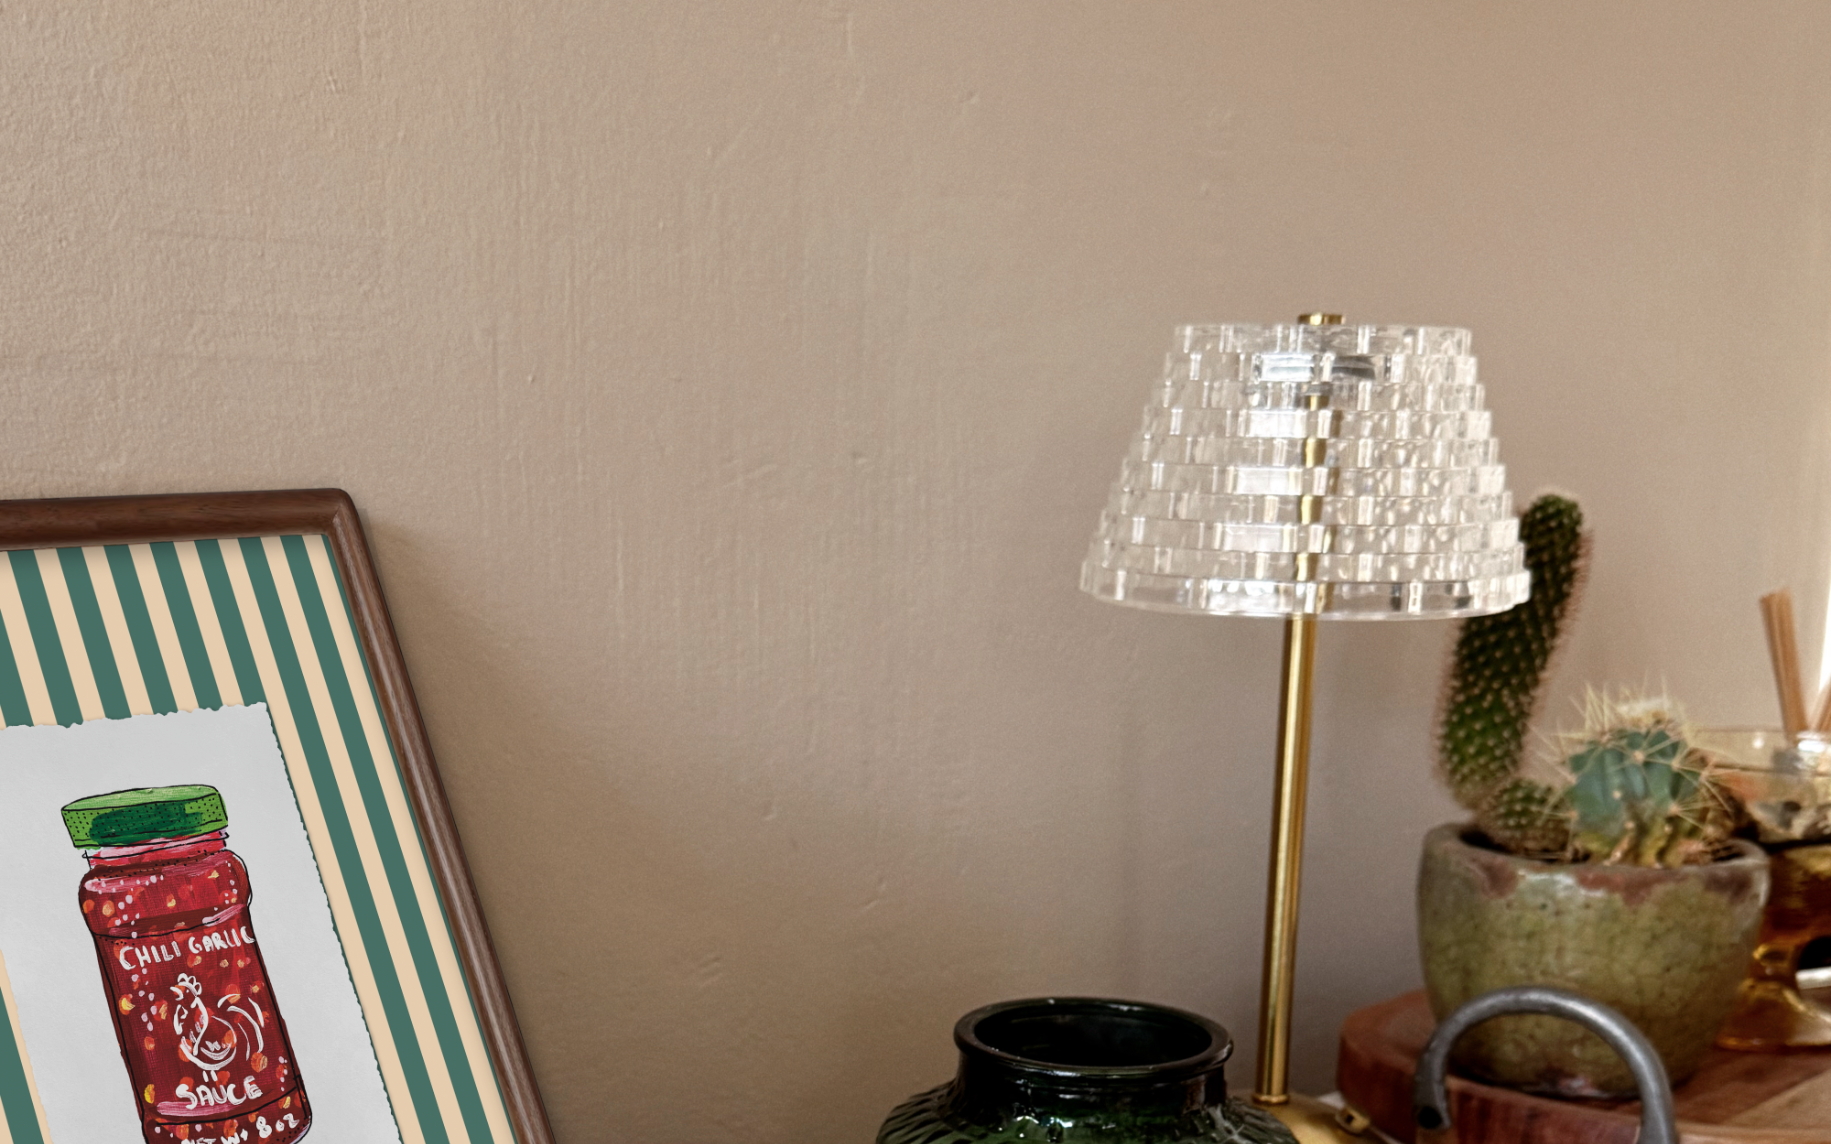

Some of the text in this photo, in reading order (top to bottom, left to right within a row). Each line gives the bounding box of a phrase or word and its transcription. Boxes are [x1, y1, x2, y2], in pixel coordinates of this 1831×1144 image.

[119, 926, 255, 970] CHILI GARLIC
[175, 1075, 263, 1110] SAUCE
[256, 1116, 272, 1138] 8
